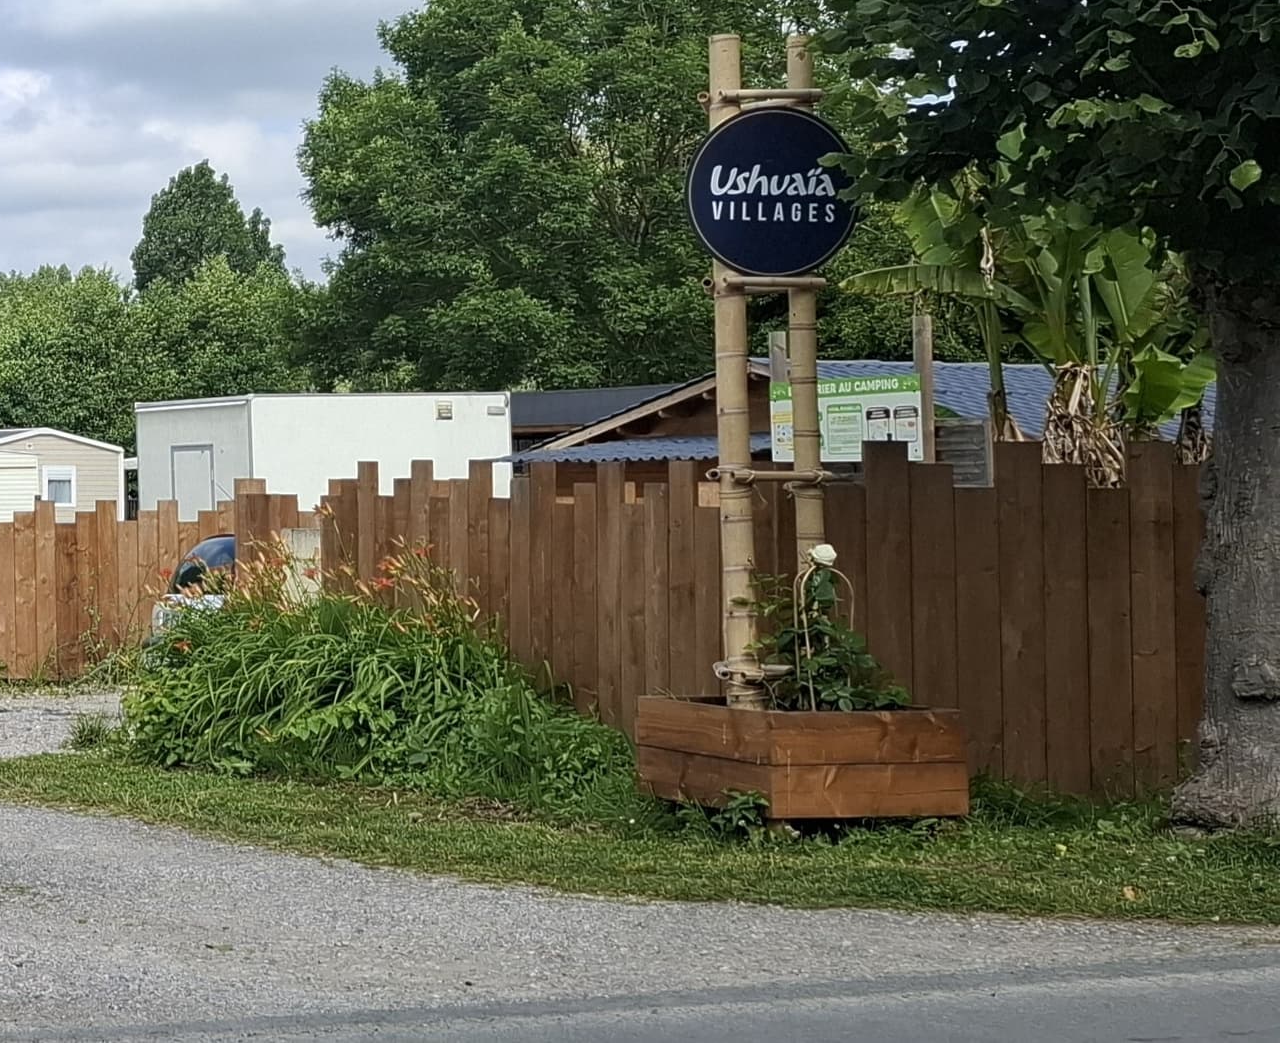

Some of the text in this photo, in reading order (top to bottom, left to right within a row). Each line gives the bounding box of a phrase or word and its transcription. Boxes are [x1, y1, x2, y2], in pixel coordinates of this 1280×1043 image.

[710, 164, 836, 197] Ushuaïa
[711, 200, 836, 223] VILLAGES
[838, 381, 851, 393] AU
[854, 378, 900, 391] CAMPING
